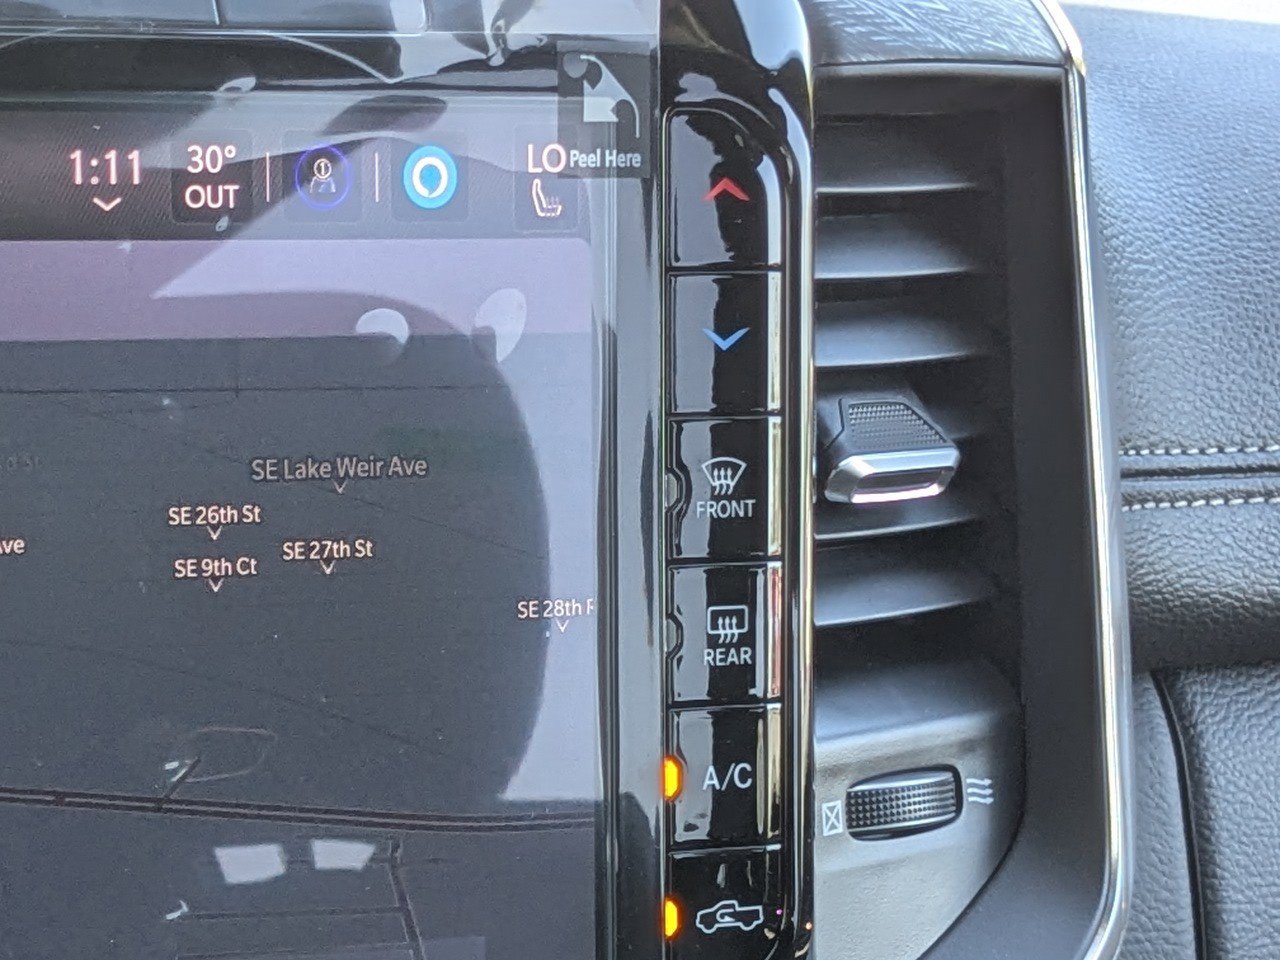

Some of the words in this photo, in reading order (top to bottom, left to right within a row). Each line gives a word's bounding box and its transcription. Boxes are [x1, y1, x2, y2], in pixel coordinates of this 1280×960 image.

[69, 148, 141, 186] 1:11
[186, 144, 237, 174] 30°
[527, 143, 567, 173] LO
[570, 148, 601, 168] Peel
[605, 150, 641, 167] Here
[184, 185, 239, 209] OUT
[252, 459, 279, 481] SE
[284, 457, 332, 479] Lake
[337, 456, 382, 479] Weir
[387, 456, 427, 477] Ave
[168, 507, 191, 526] SE
[195, 505, 237, 525] 26th
[241, 504, 261, 523] St
[697, 500, 755, 518] FRONT
[283, 541, 305, 560] SE
[308, 540, 350, 559] 27th
[354, 539, 373, 557] St
[174, 559, 198, 578] SE
[201, 558, 231, 577] 9th
[236, 557, 257, 575] Ct
[517, 600, 539, 618] SE
[543, 599, 581, 617] 28th
[704, 647, 752, 666] REAR
[703, 763, 752, 789] A/C
